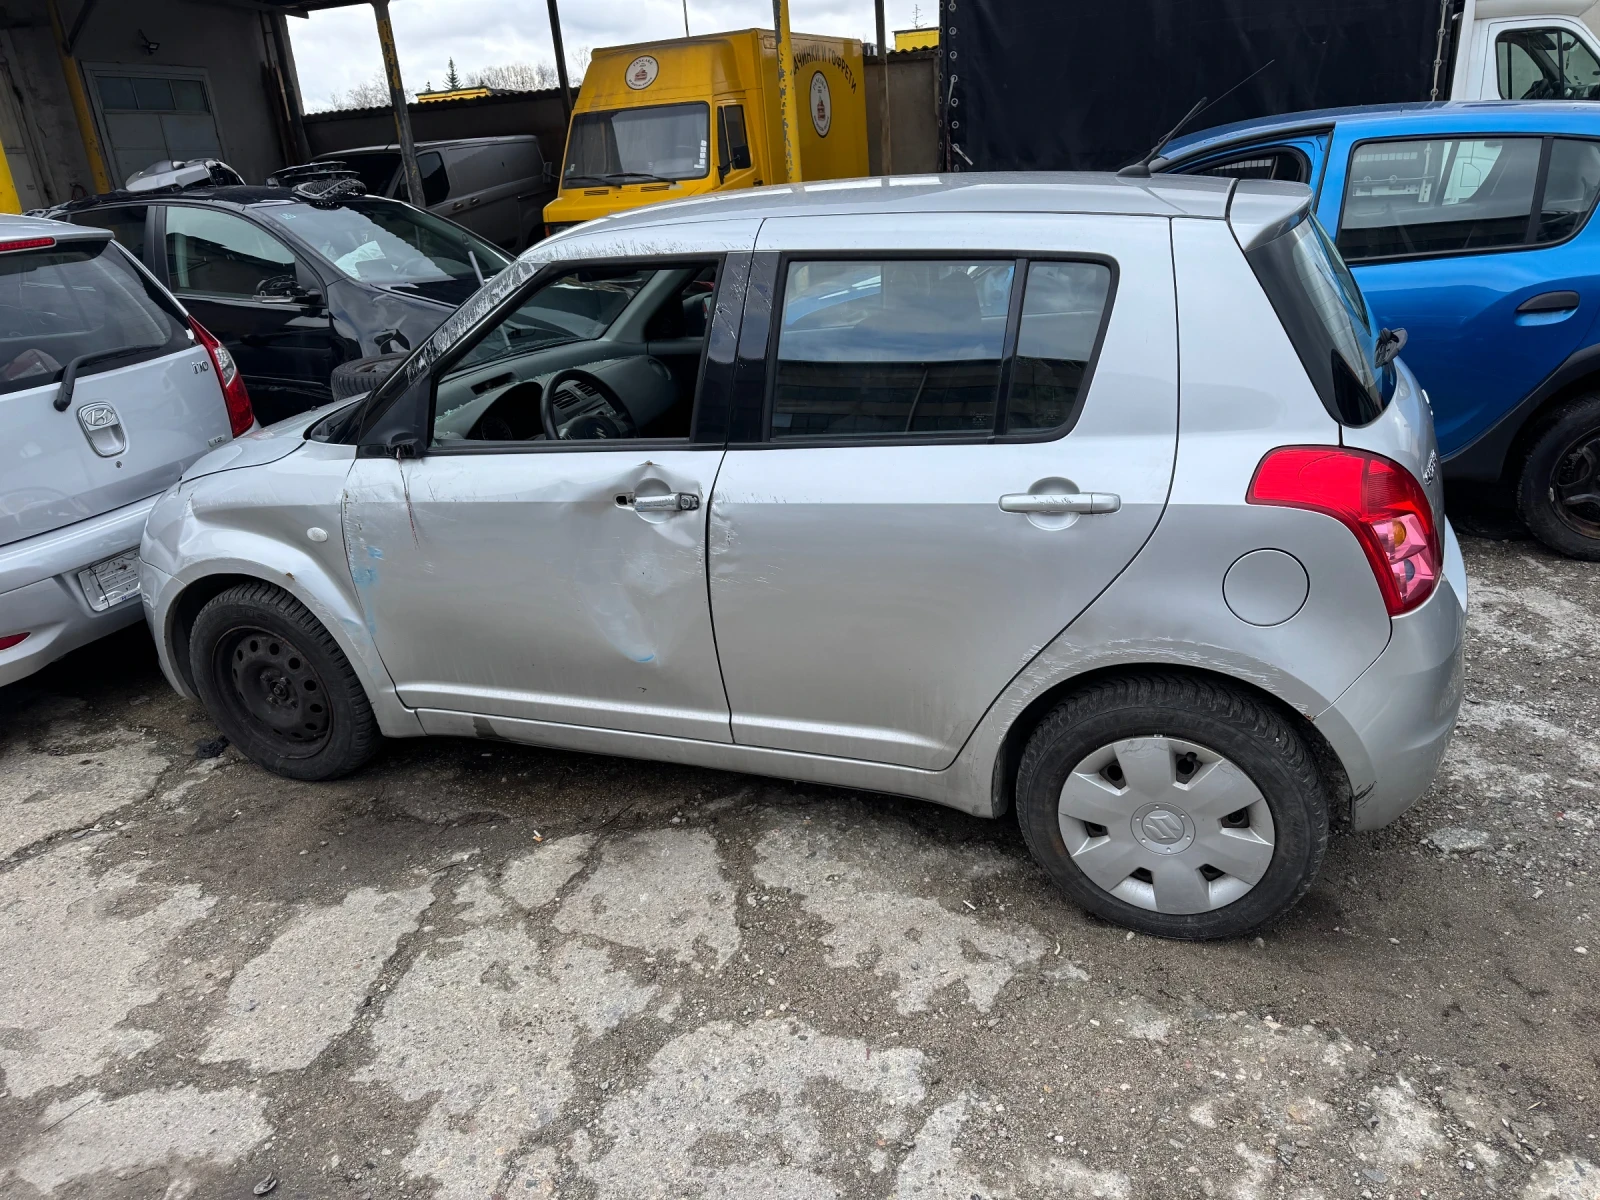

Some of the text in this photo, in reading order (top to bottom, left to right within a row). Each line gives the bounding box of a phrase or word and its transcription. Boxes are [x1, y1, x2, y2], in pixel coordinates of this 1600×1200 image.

[793, 44, 820, 76] АЧИНКИ
[828, 48, 857, 94] ГОФРЕТИ
[191, 360, 209, 375] i10
